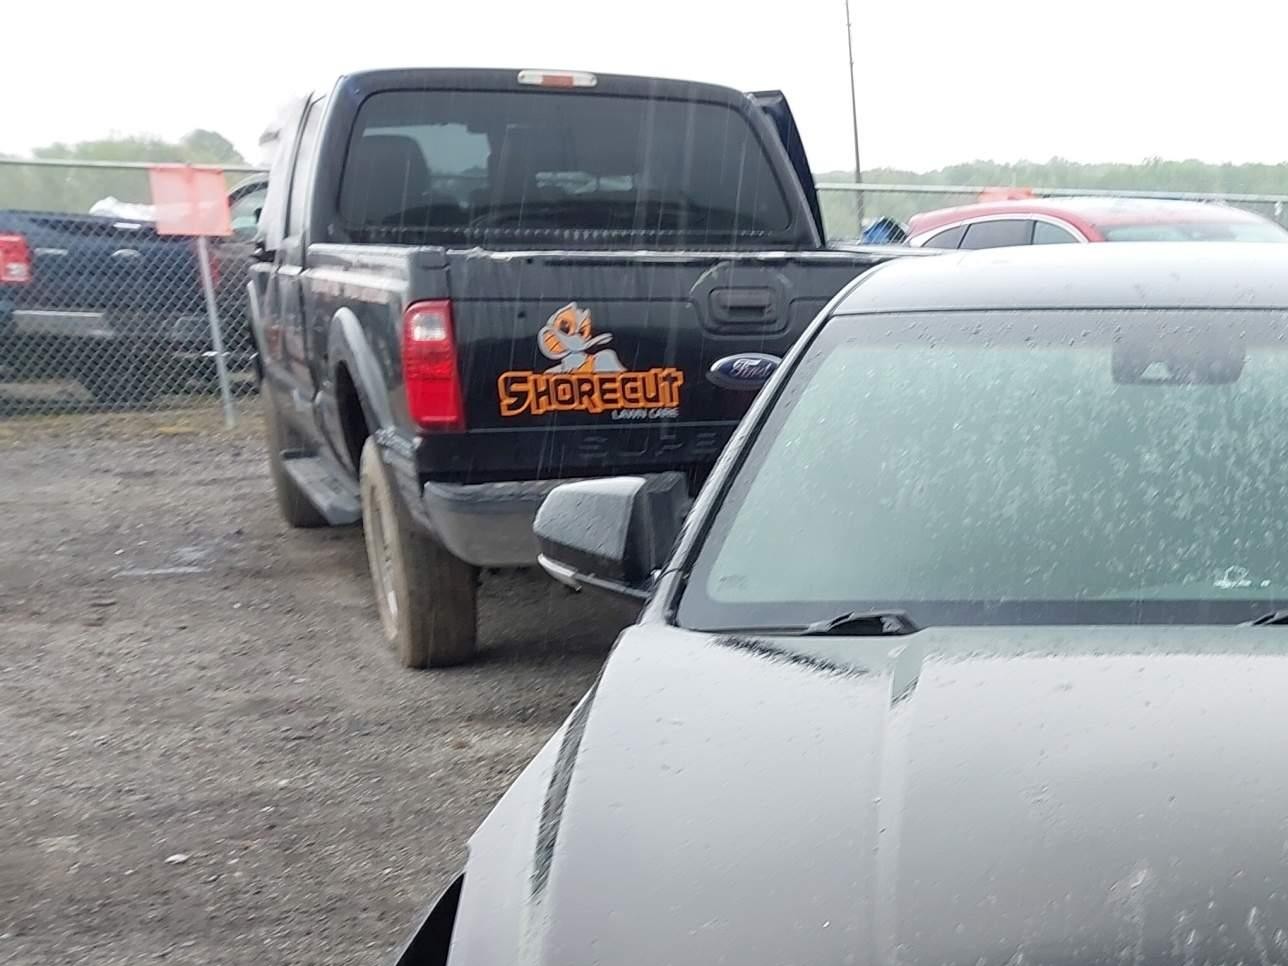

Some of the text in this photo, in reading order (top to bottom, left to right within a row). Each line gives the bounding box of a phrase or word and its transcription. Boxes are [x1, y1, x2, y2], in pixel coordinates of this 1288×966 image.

[729, 359, 773, 378] Ford
[498, 368, 684, 416] SHORECUT
[611, 409, 648, 420] LAWN
